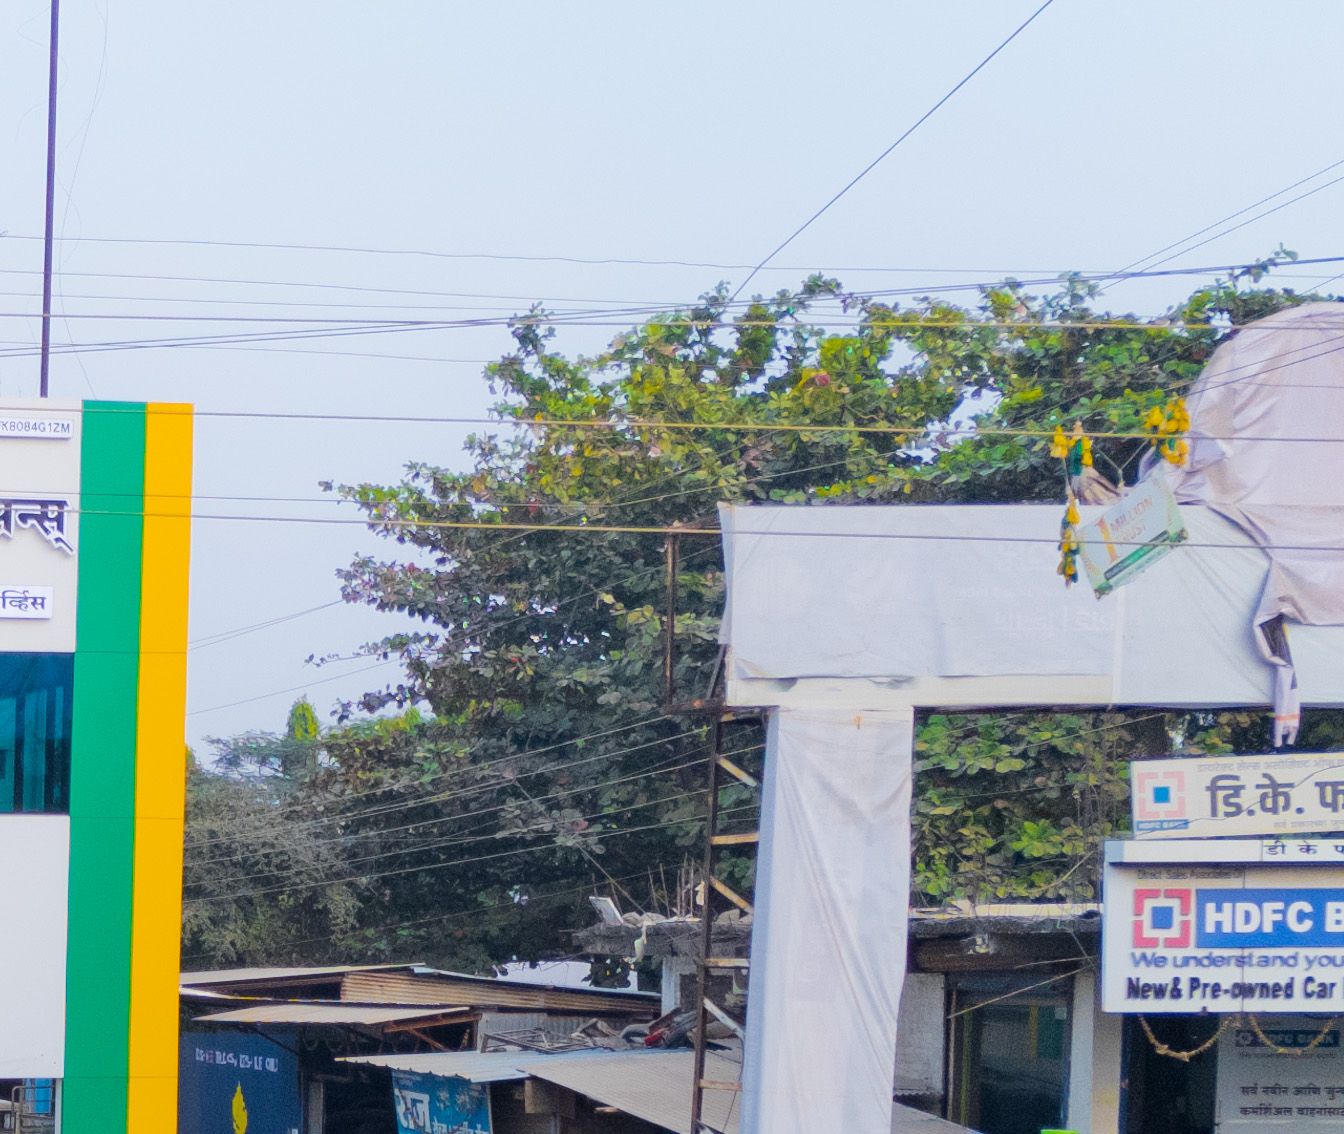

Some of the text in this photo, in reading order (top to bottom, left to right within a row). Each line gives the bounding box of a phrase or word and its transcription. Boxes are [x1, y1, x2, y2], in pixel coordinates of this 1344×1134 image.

[1205, 901, 1314, 934] HDFC
[1130, 951, 1168, 968] We
[1172, 951, 1299, 968] understand
[1188, 976, 1295, 1000] Pre-owned
[1304, 975, 1337, 999] Car
